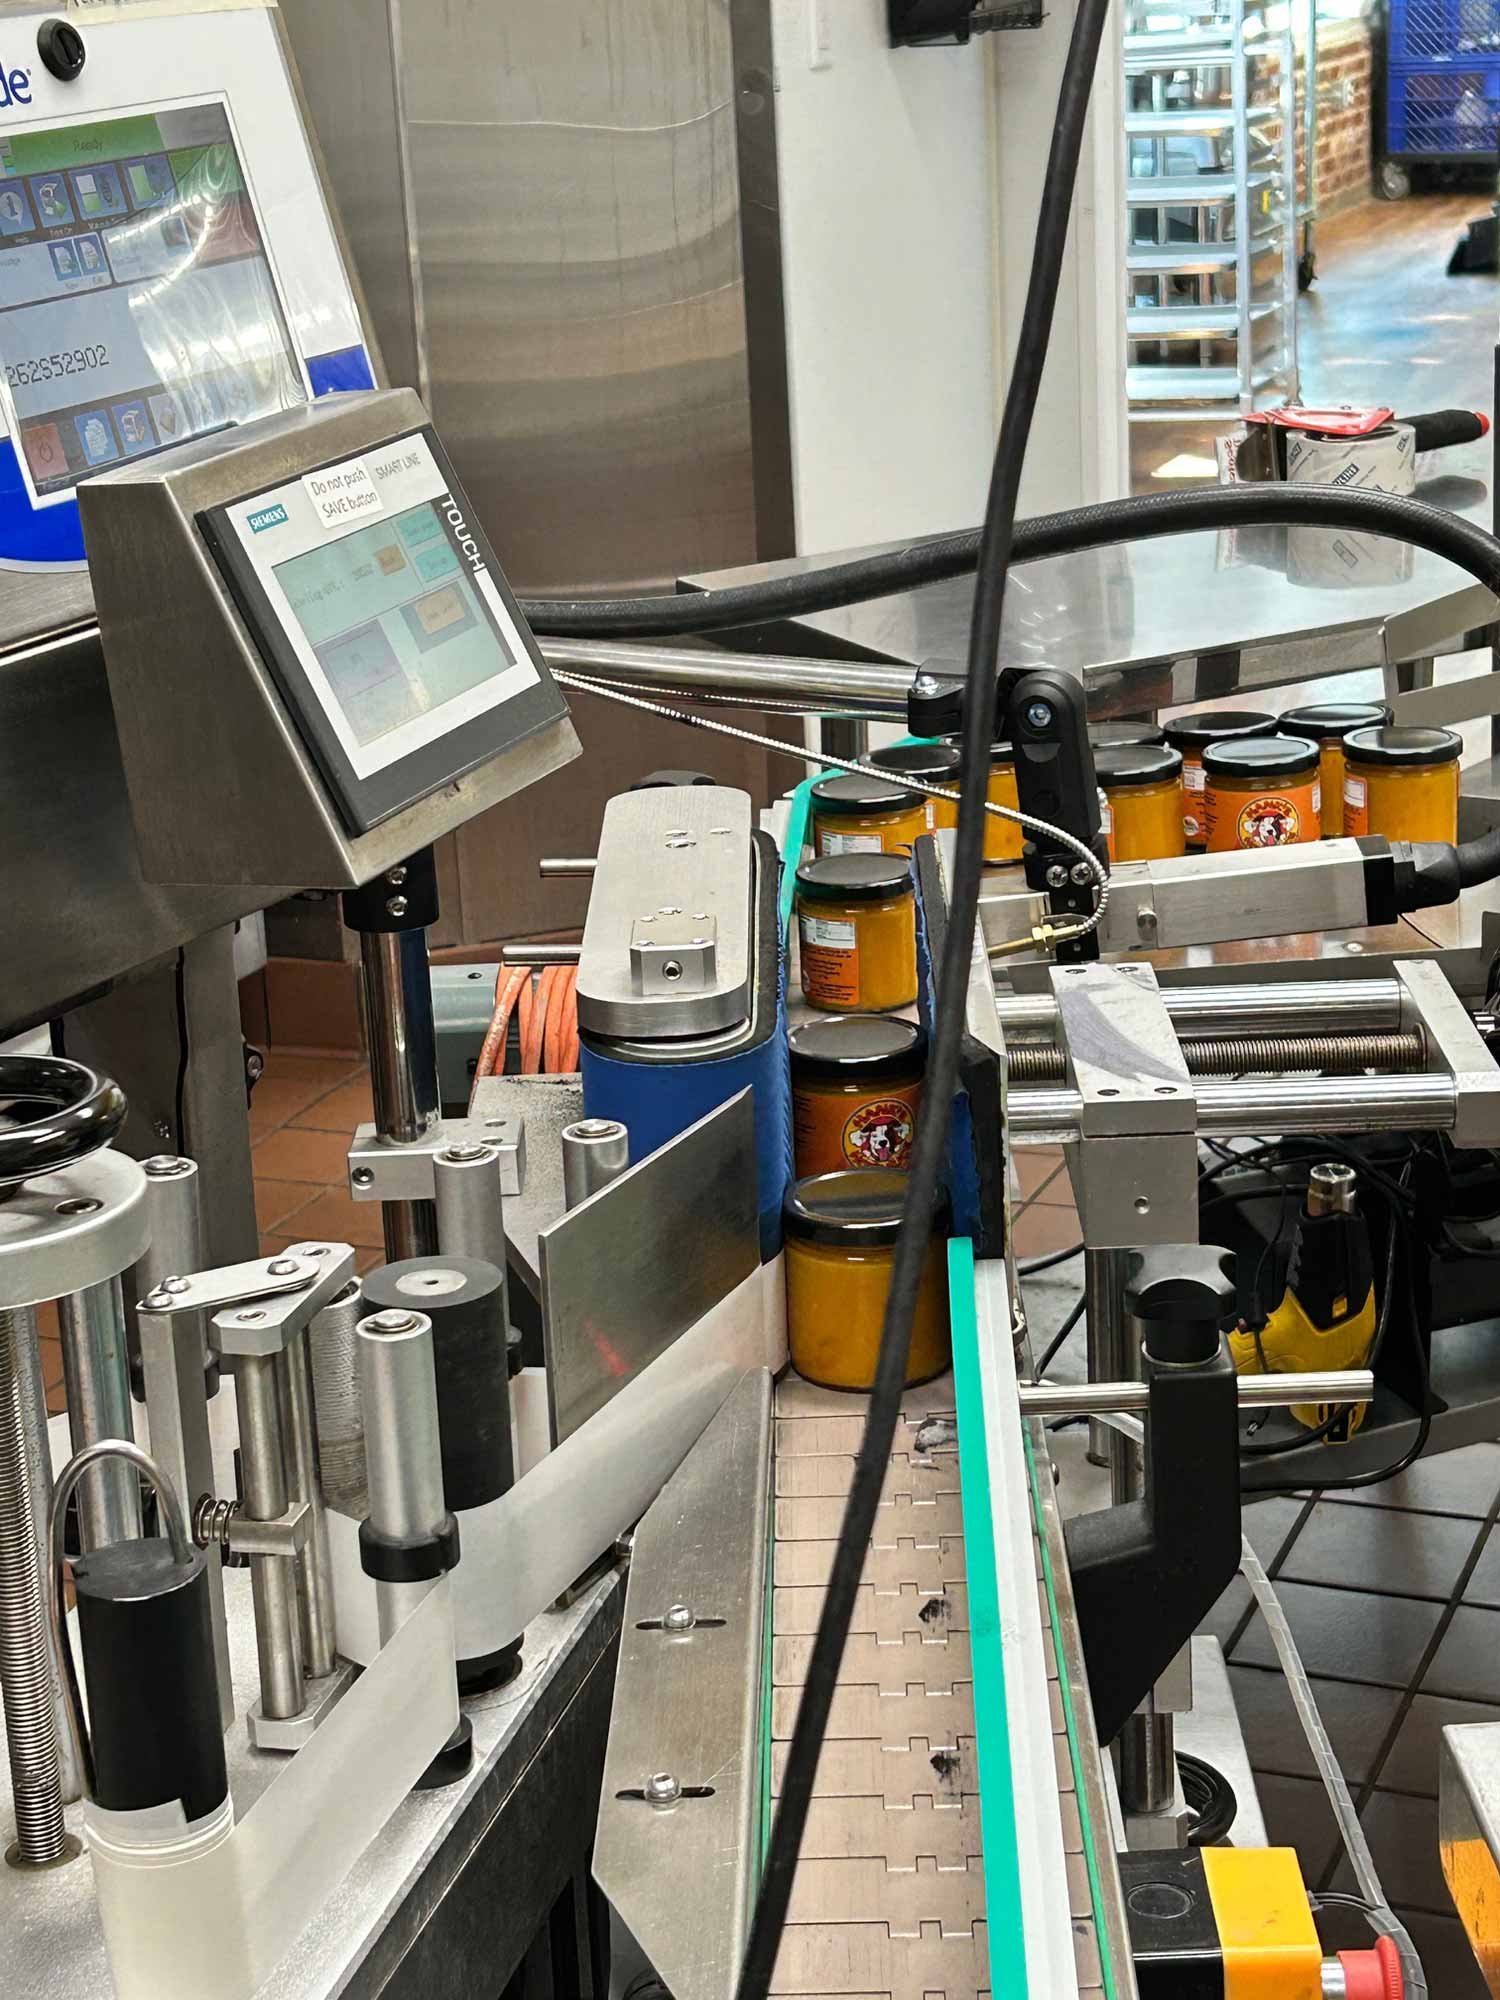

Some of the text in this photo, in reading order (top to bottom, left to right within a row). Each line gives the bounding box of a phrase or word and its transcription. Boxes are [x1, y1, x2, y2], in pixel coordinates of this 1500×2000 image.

[375, 452, 421, 480] SMART LINE
[311, 467, 366, 496] Do not push
[322, 490, 377, 518] SAVE button
[250, 507, 286, 530] SIEMENS
[441, 493, 486, 571] TOUCH
